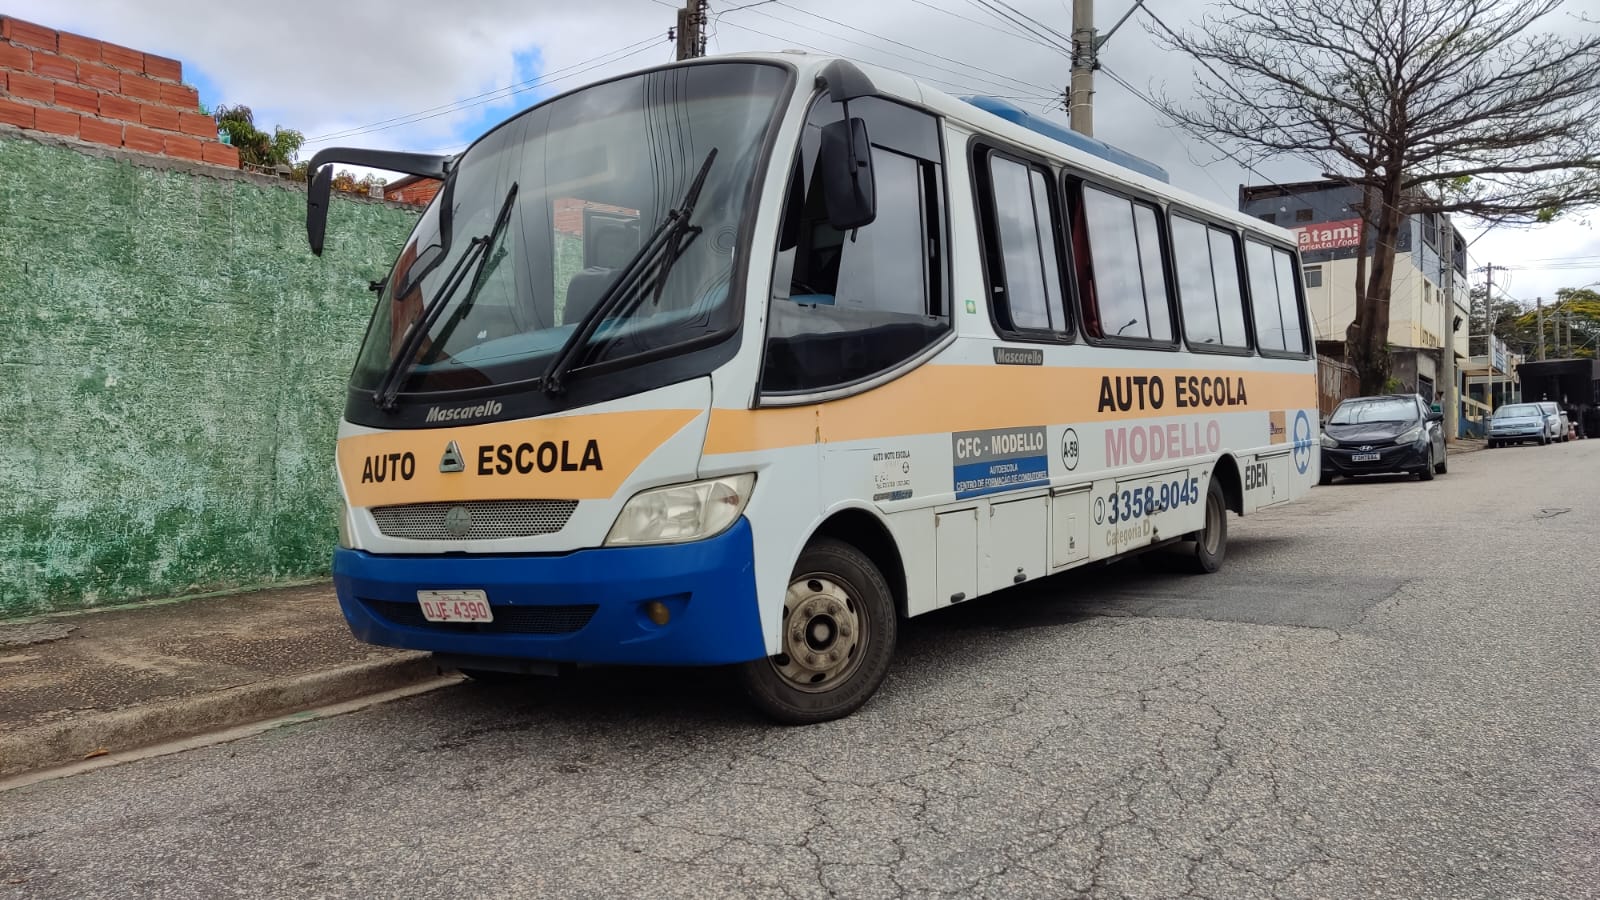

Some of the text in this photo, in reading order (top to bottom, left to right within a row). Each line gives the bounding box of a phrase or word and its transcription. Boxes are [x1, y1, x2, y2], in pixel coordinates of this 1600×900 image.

[997, 349, 1042, 364] Mascarello
[1097, 375, 1247, 412] AUTO ESCOLA
[425, 400, 503, 423] Mascarello
[957, 437, 981, 458] CFC
[991, 432, 1044, 455] MODELLO
[1063, 441, 1078, 458] A-59
[1104, 419, 1221, 468] MODELLO
[361, 439, 604, 484] AUTO ESCOLA
[1245, 459, 1268, 490] ÉDEN
[957, 481, 977, 491] CENTRO
[978, 479, 984, 487] DE
[1107, 477, 1199, 525] 3358-9045
[1106, 523, 1142, 547] Categoria
